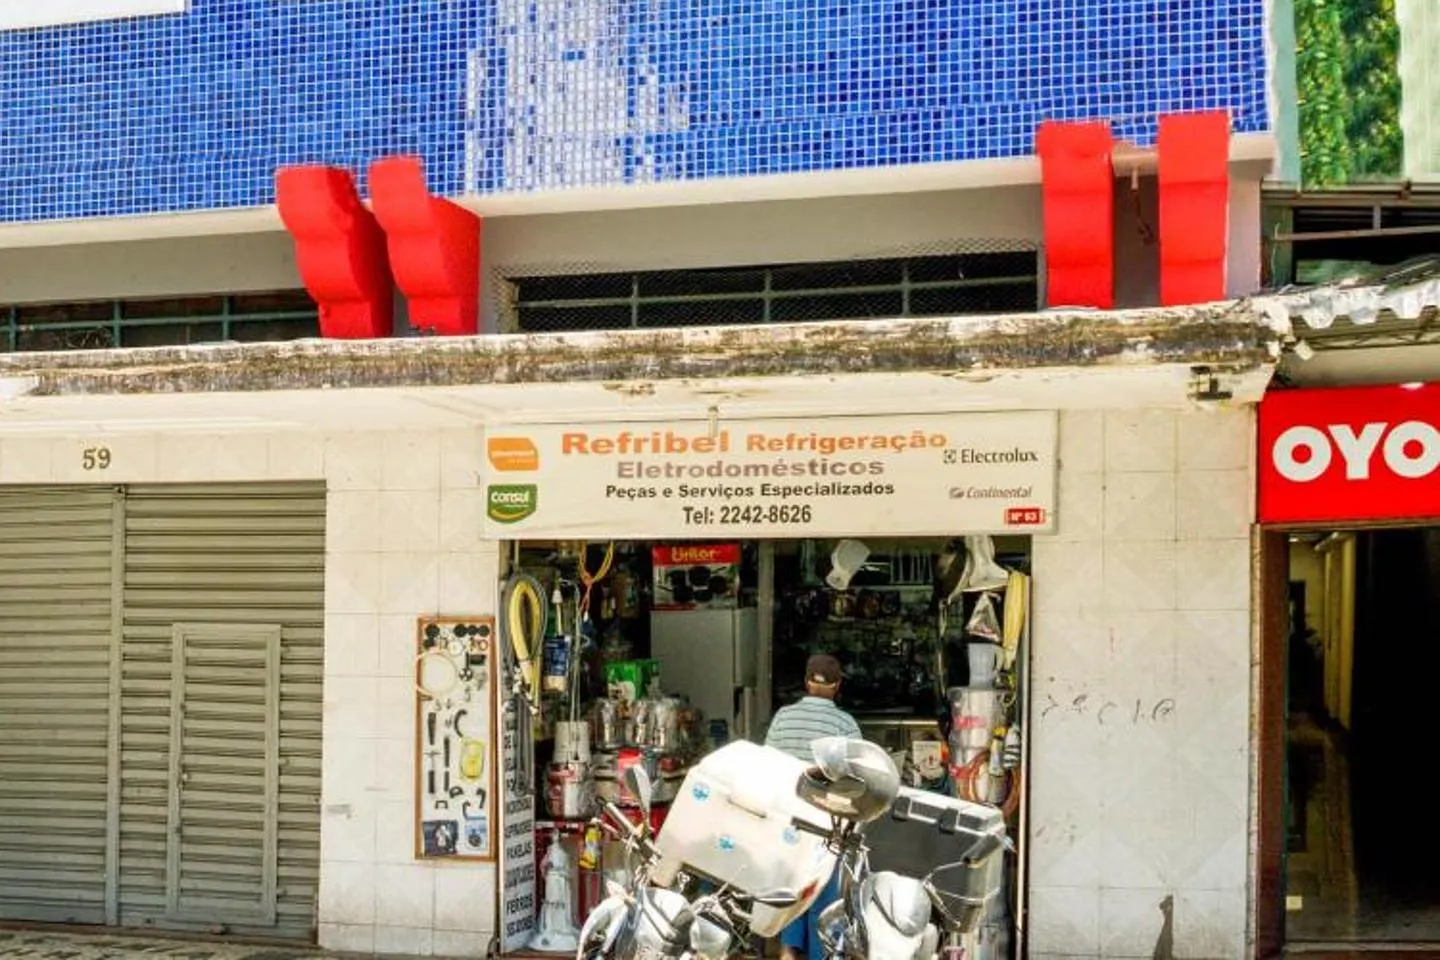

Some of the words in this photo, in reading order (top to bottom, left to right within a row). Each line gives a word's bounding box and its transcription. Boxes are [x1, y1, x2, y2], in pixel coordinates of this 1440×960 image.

[561, 431, 729, 455] Refribel
[747, 431, 947, 454] Refrigeração
[1272, 421, 1440, 482] OYO
[82, 448, 111, 470] 59
[961, 448, 1038, 464] Electrolux
[617, 458, 885, 479] Eletrodomésticos
[606, 484, 657, 500] Peças
[663, 489, 673, 498] e
[678, 484, 754, 500] Serviços
[760, 482, 895, 499] Especializados
[682, 506, 714, 524] Tel:
[720, 505, 812, 524] 2242-8626
